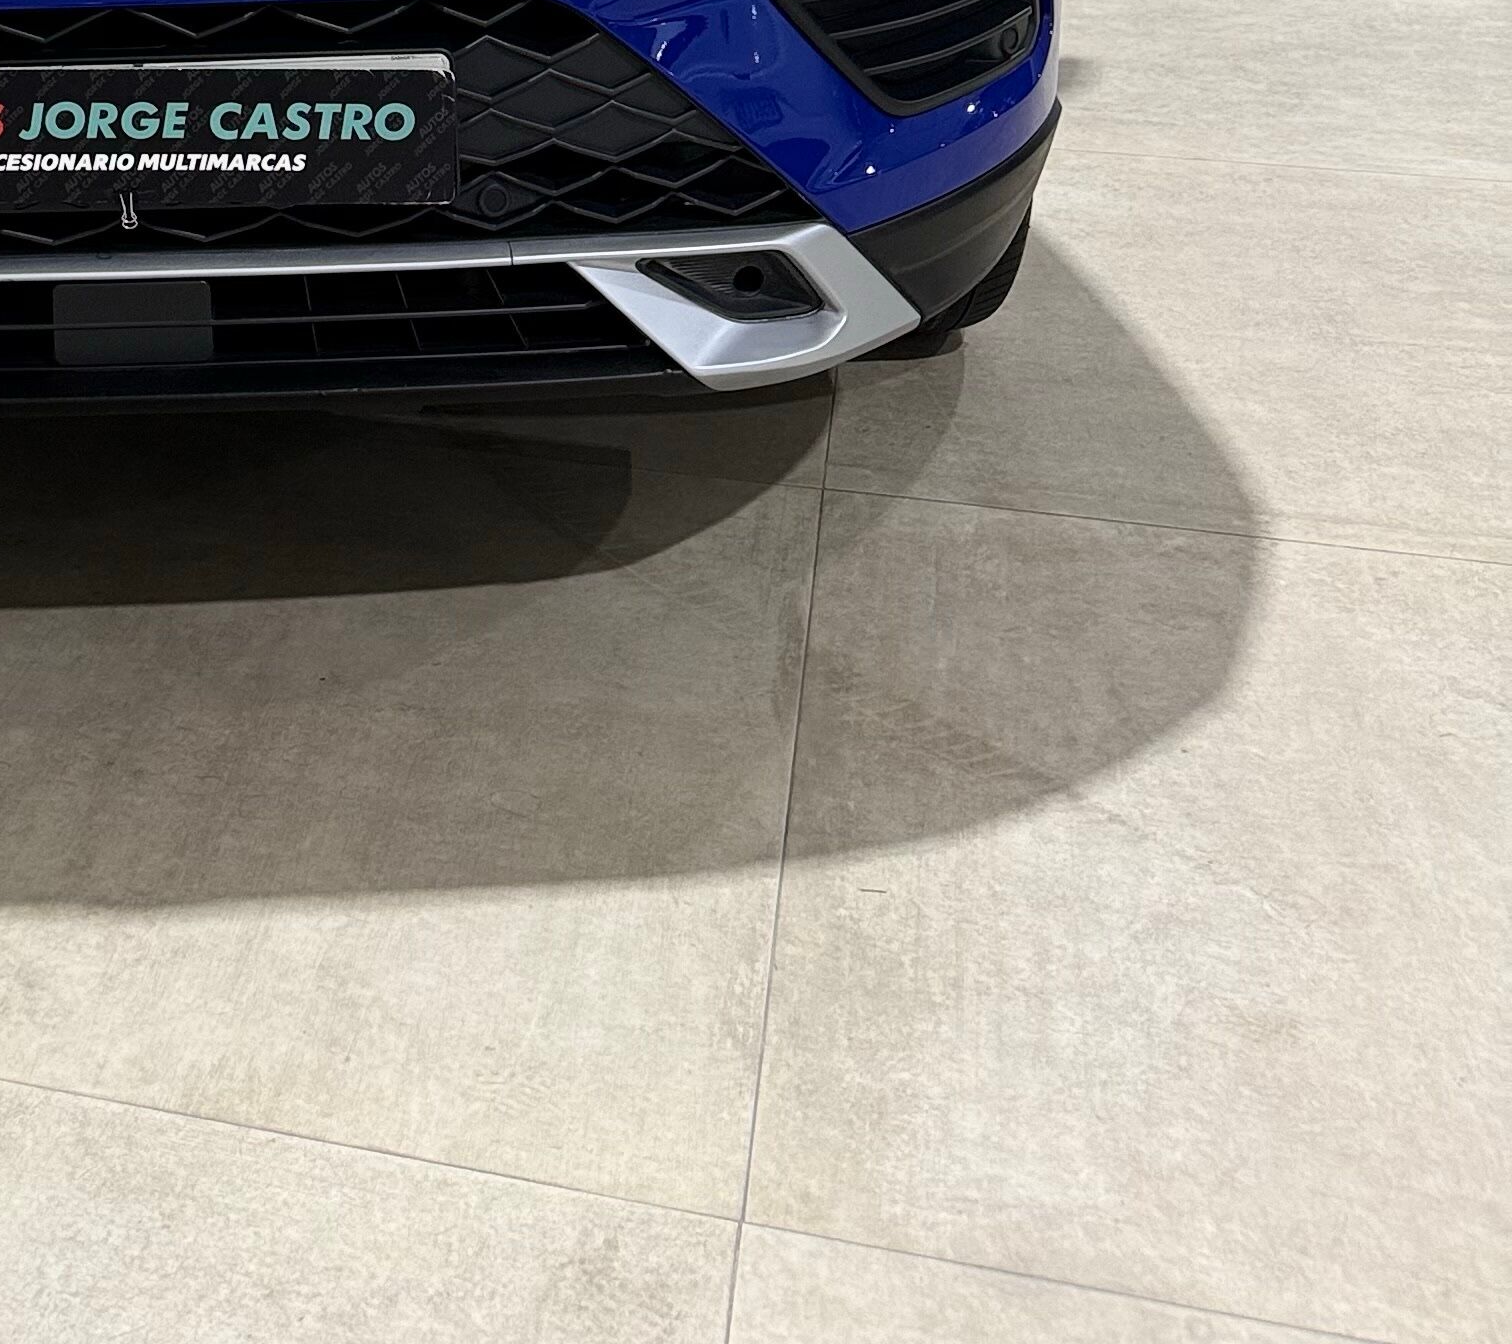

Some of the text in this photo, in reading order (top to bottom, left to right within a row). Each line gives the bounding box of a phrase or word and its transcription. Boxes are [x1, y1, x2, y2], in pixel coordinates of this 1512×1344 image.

[18, 101, 189, 140] JORGE
[210, 102, 416, 141] CASTRO
[137, 153, 307, 172] MULTIMARCAS
